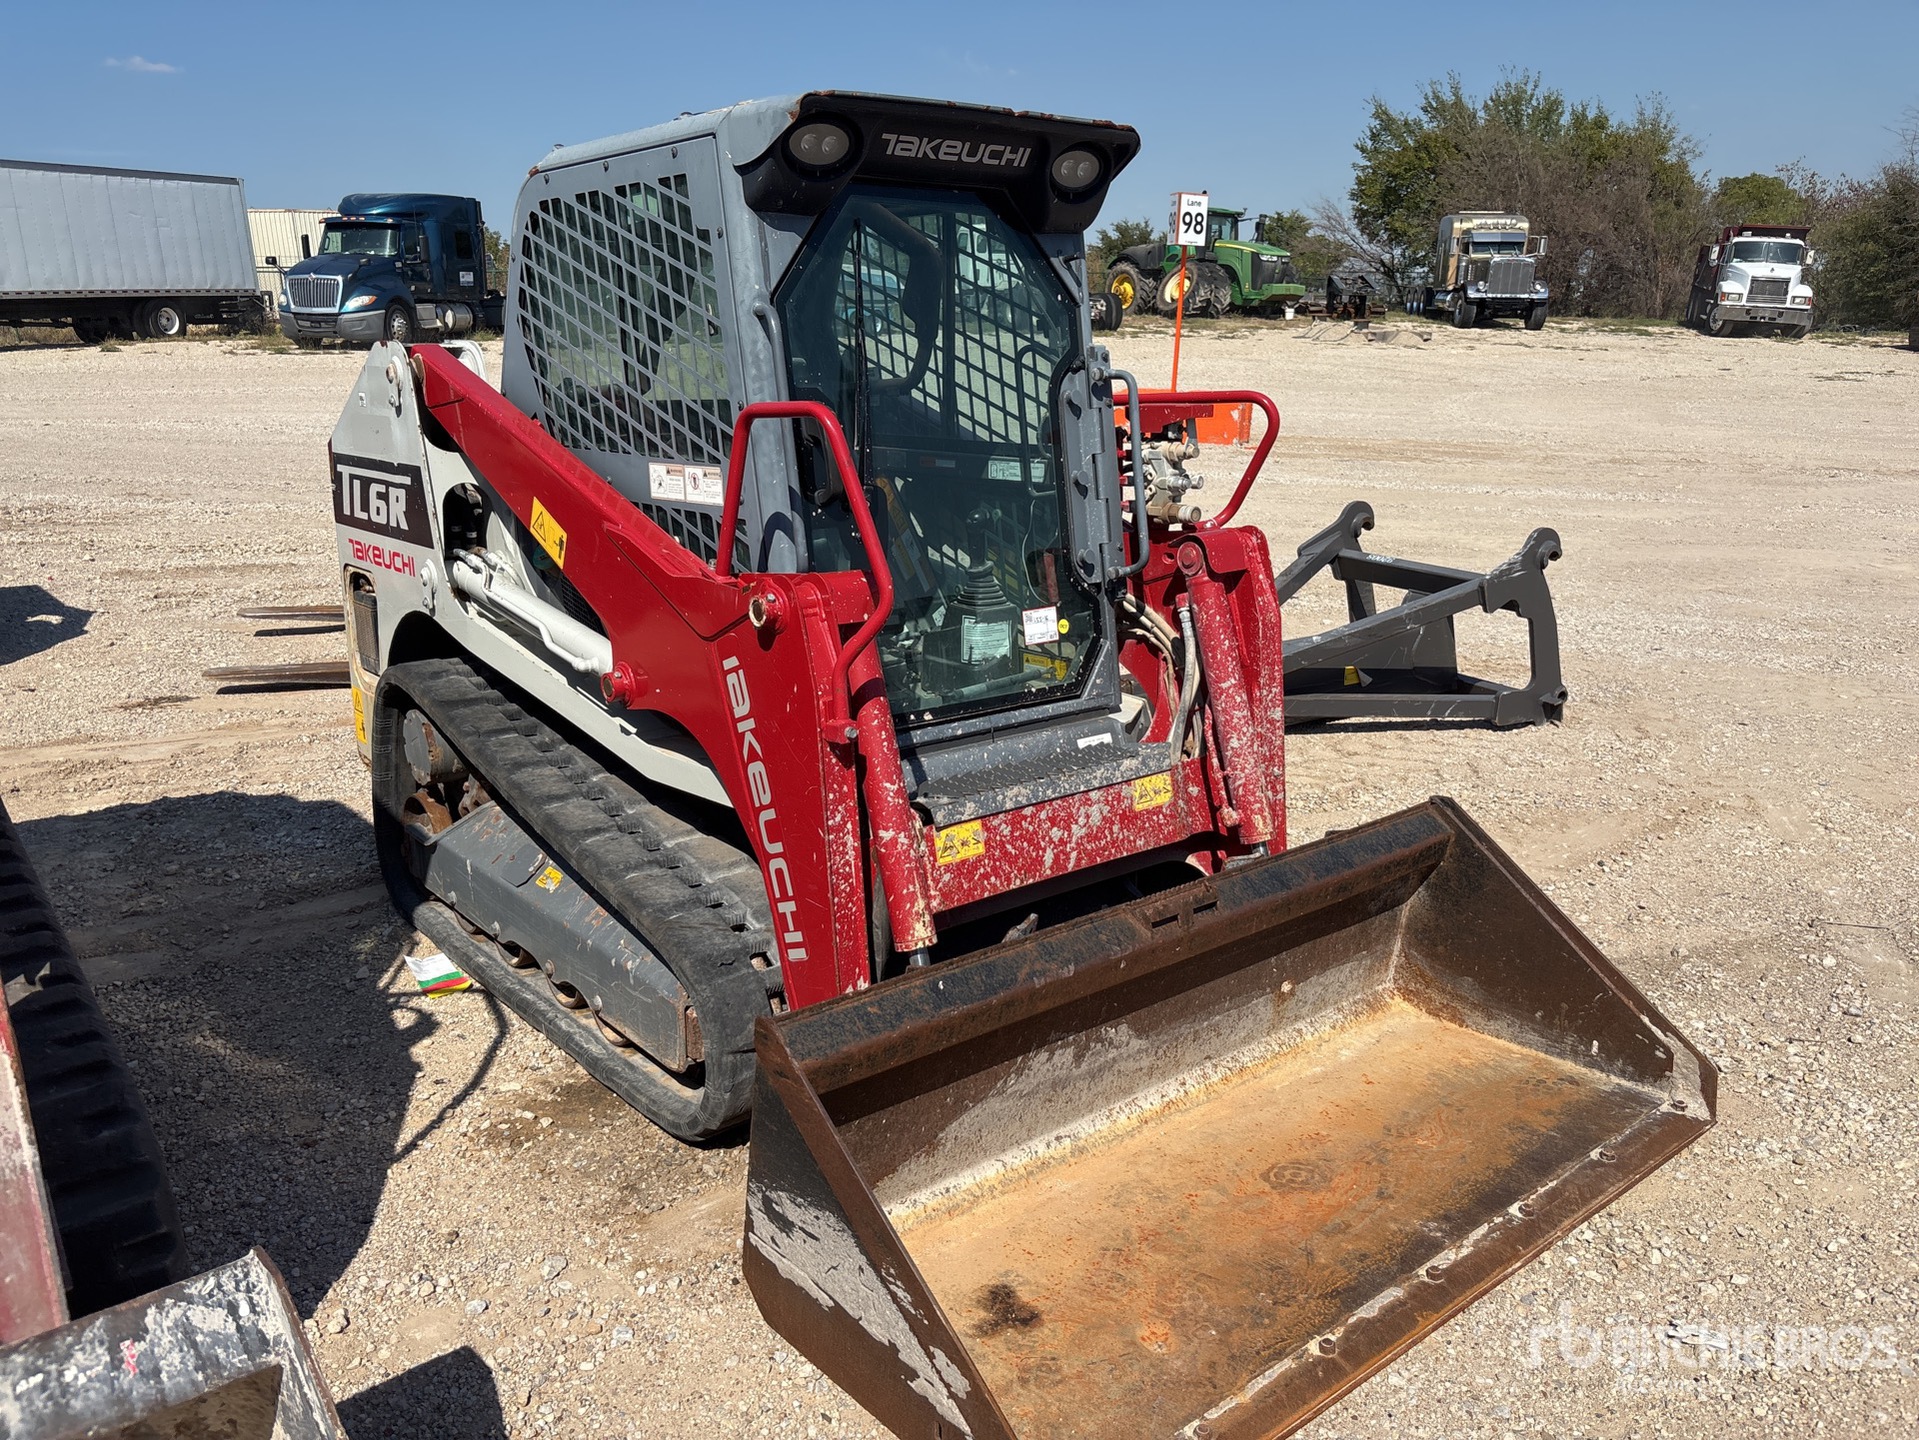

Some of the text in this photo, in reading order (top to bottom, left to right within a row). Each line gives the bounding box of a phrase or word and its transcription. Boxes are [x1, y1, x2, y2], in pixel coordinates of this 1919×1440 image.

[1187, 199, 1202, 207] Lane
[1182, 211, 1204, 235] 98
[336, 464, 412, 531] TL6R
